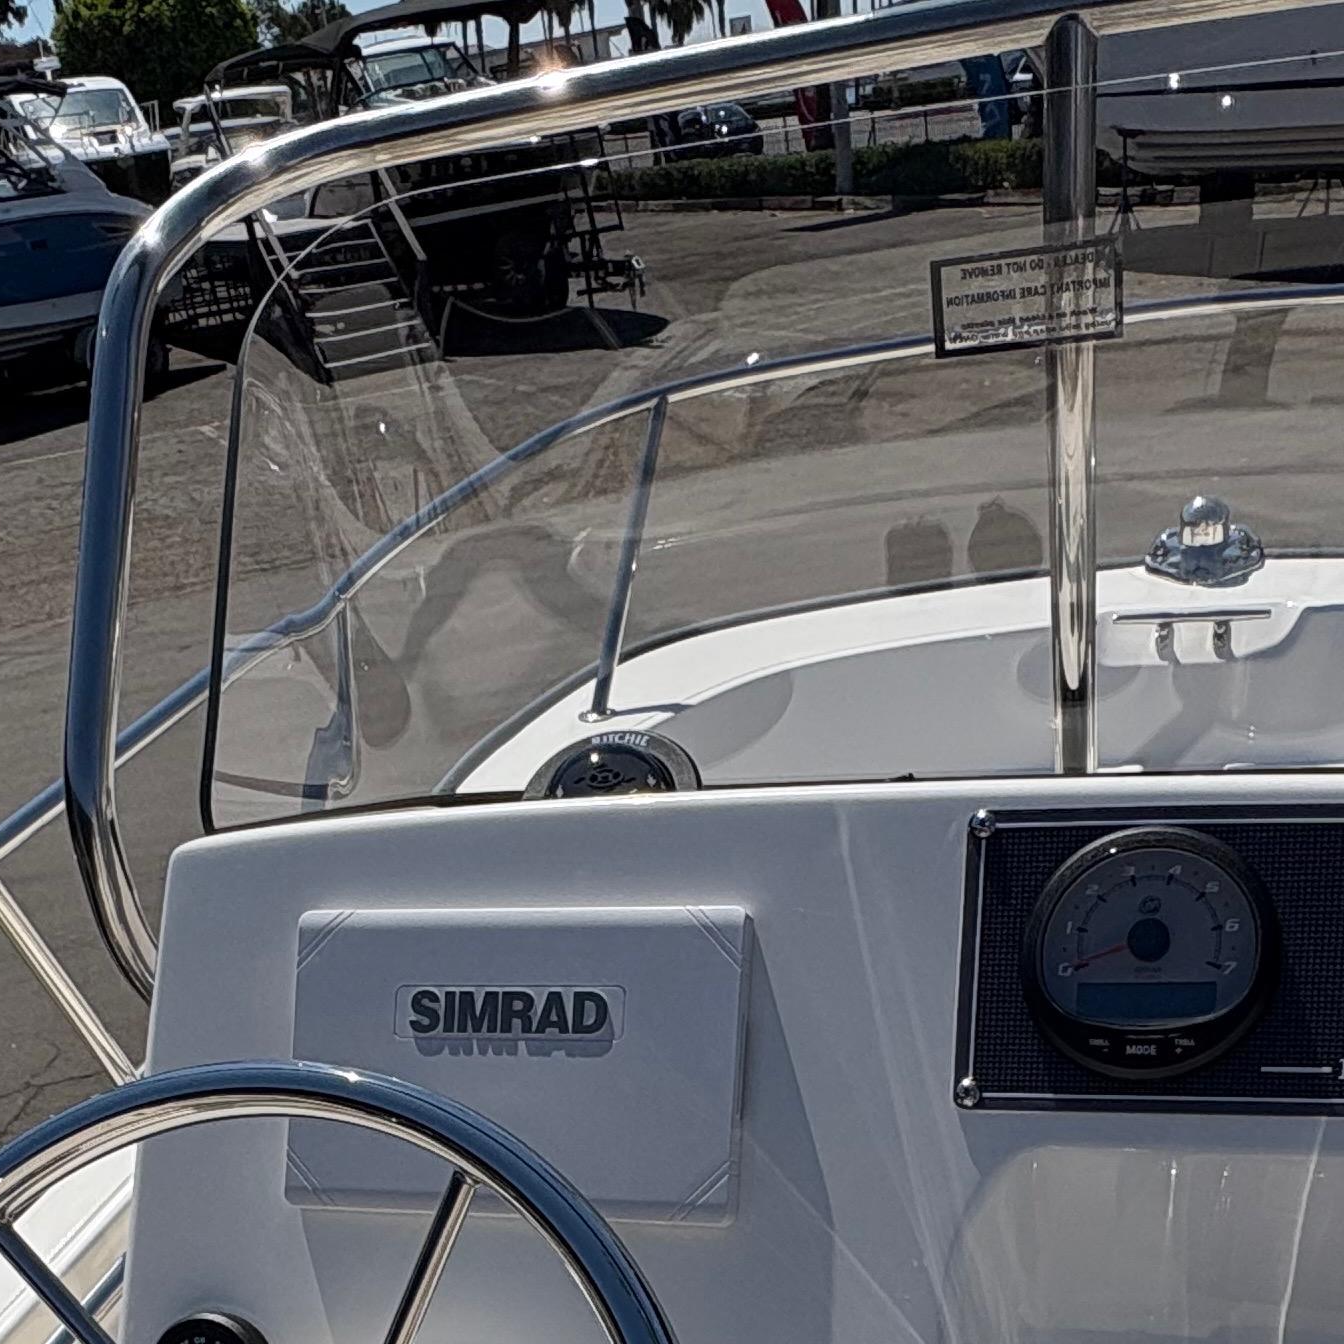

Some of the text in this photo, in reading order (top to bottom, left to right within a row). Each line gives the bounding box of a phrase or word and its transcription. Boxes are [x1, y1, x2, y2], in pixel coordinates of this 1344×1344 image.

[591, 732, 650, 747] RITCHIE
[1066, 921, 1073, 935] 1
[1225, 918, 1240, 932] 6
[1224, 961, 1237, 975] 7
[408, 989, 610, 1035] SIMRAD
[1126, 1045, 1157, 1056] MODE
